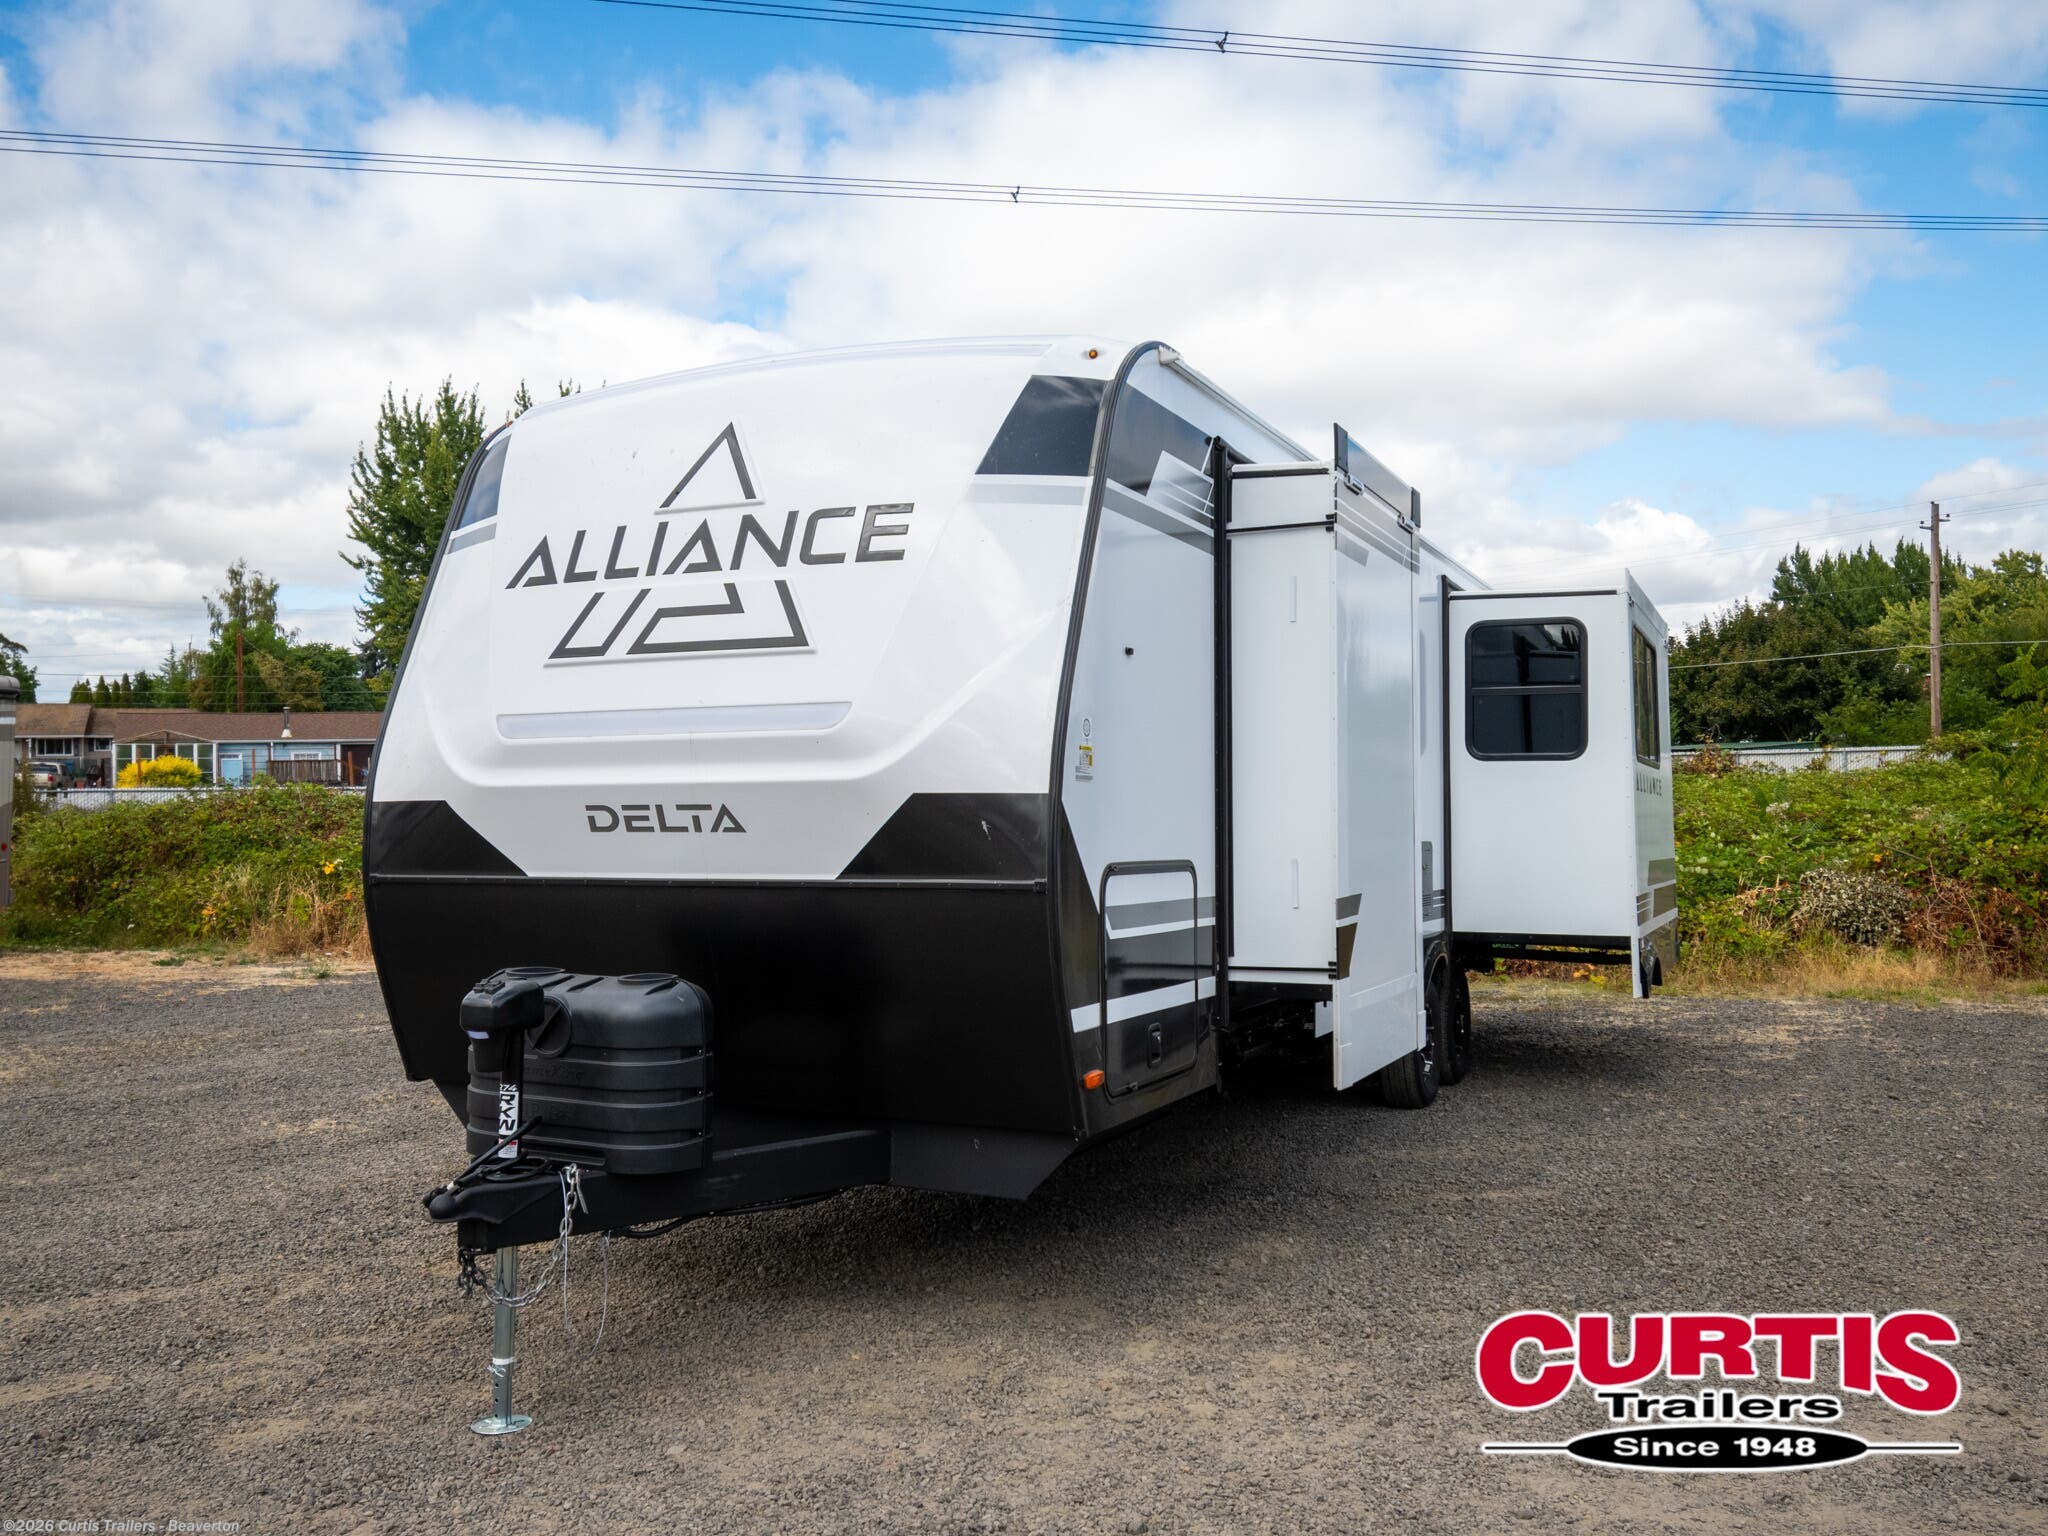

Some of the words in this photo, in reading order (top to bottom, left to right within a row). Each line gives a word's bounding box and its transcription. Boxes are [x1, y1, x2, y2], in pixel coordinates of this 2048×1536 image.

[505, 502, 914, 590] ALLIANCE
[1636, 772, 1662, 796] ALLIANCE
[585, 803, 747, 833] DELTA
